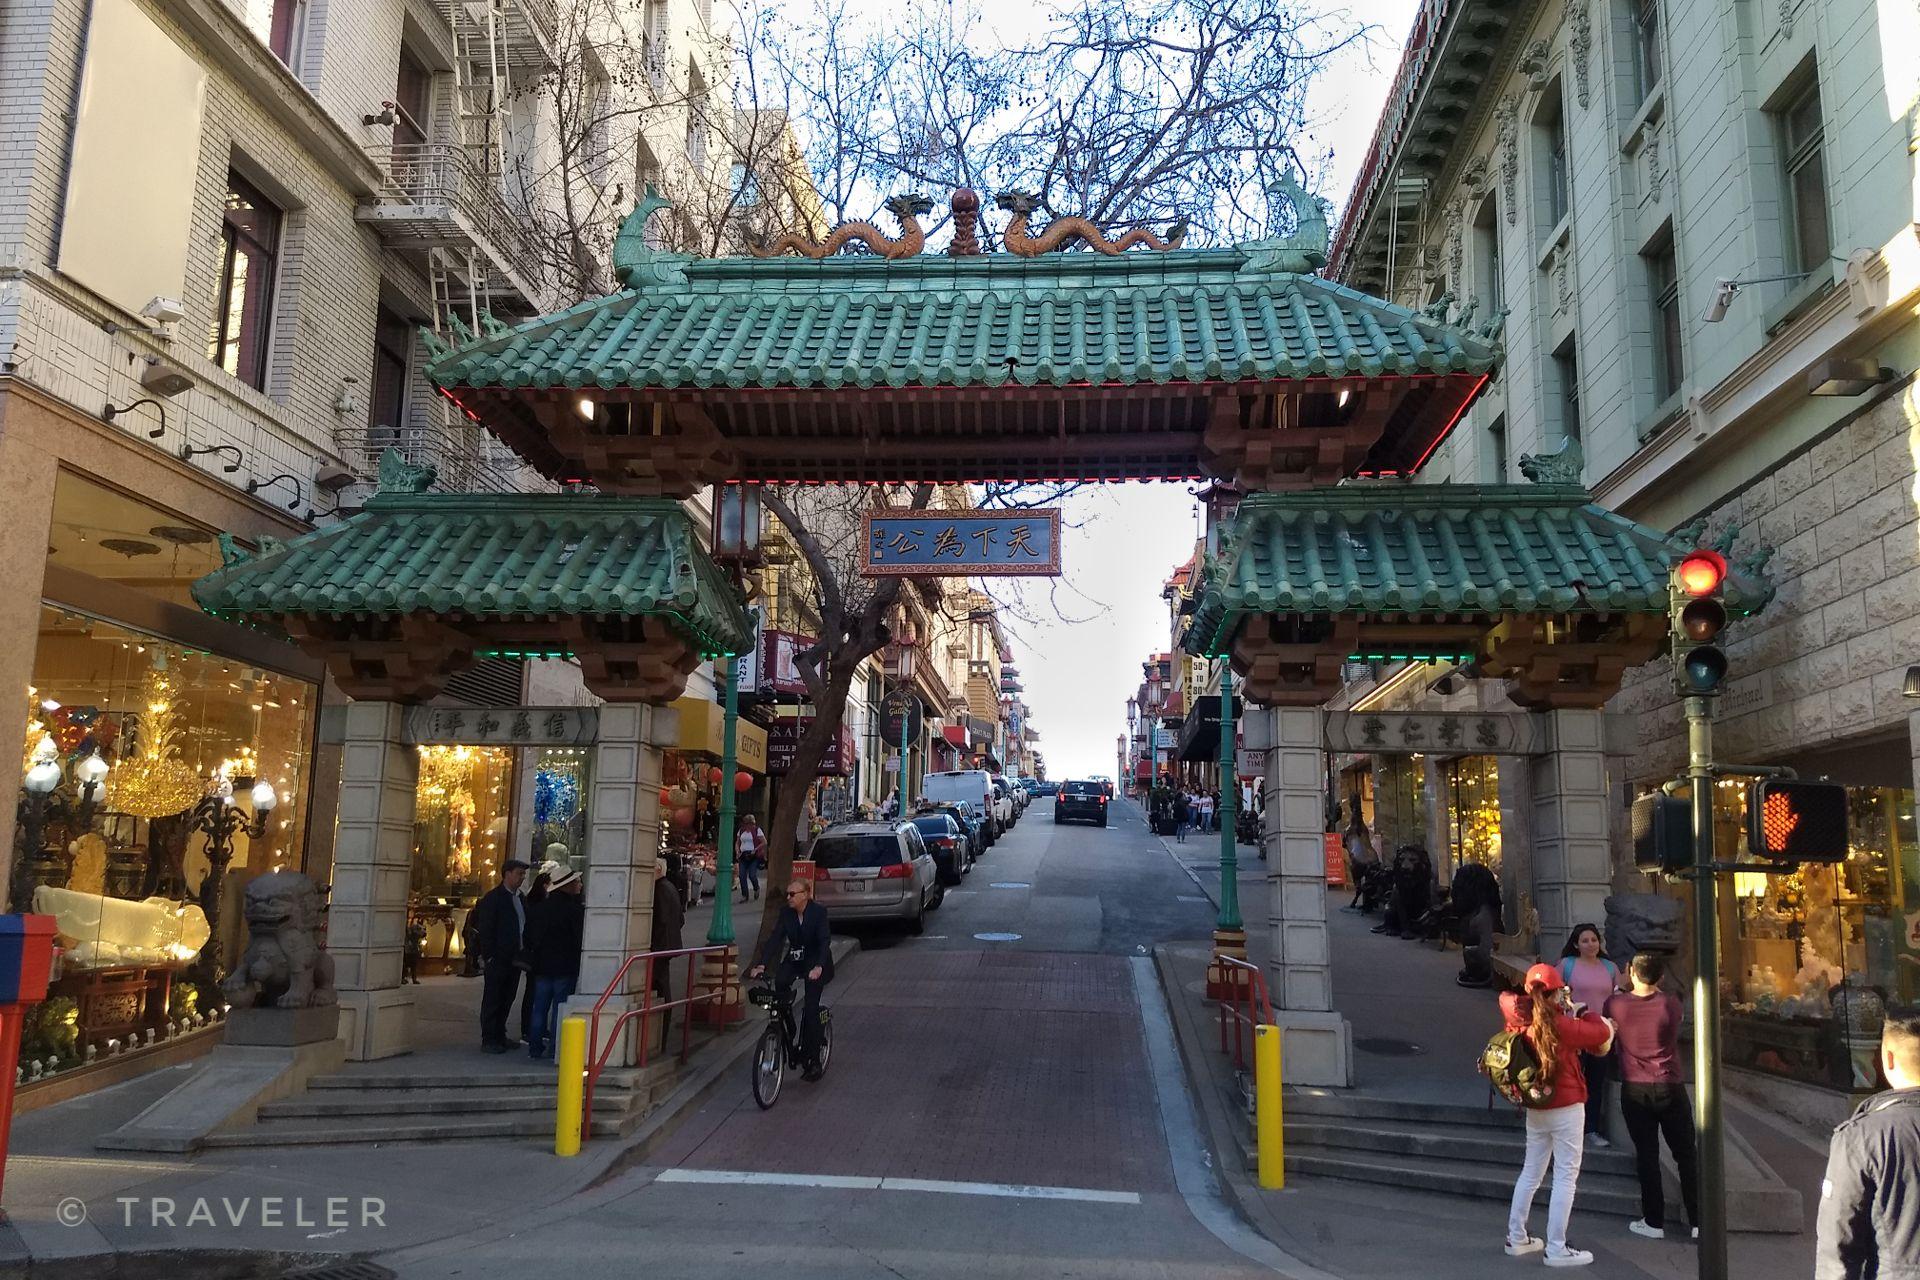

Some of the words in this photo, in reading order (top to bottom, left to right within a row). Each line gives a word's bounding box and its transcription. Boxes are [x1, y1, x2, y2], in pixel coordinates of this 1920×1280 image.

[888, 525, 1039, 558] 天下為公
[741, 735, 761, 758] GIFTS
